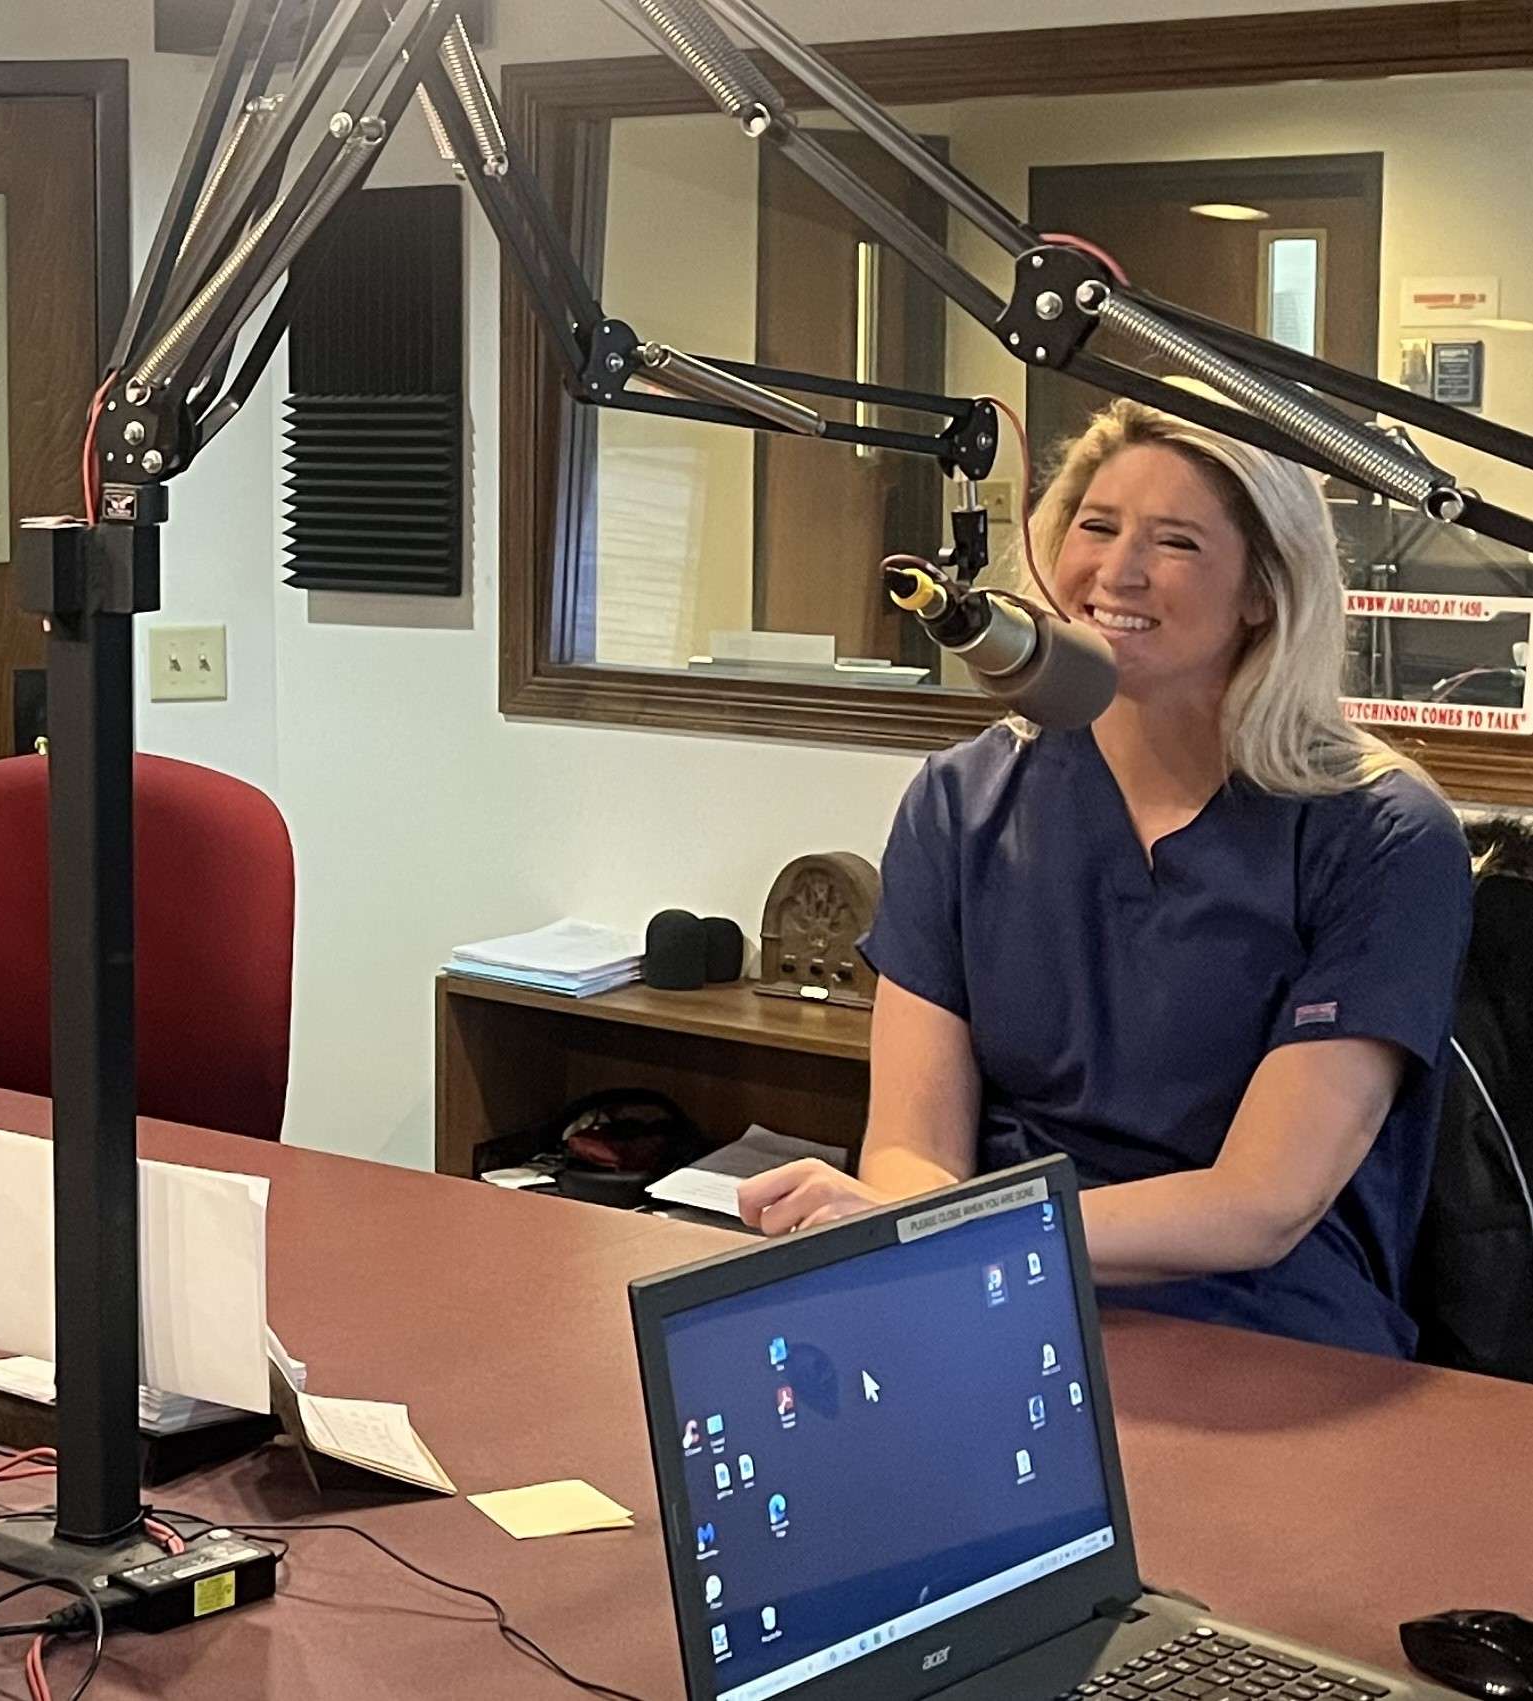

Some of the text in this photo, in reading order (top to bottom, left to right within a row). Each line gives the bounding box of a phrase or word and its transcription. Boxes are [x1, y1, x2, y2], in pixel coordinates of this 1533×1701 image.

[1388, 597, 1404, 613] AM
[1407, 598, 1440, 616] RADIO
[1442, 600, 1456, 616] AT
[1421, 706, 1463, 727] COMES
[1467, 710, 1482, 728] TO
[986, 1198, 999, 1210] YOU
[922, 1645, 951, 1671] acer
